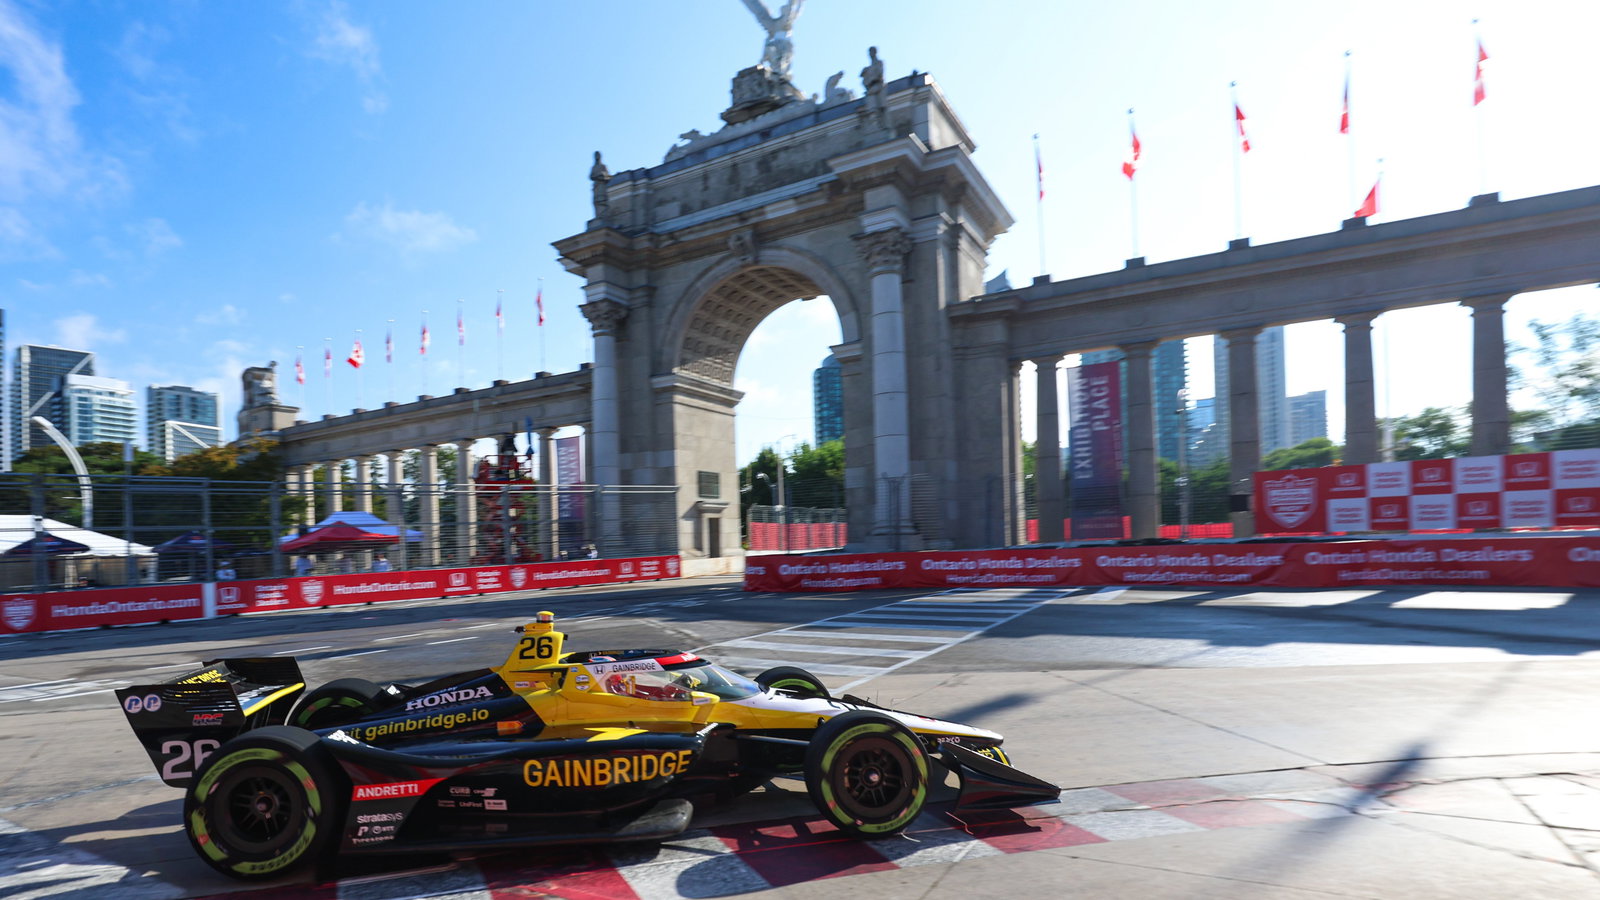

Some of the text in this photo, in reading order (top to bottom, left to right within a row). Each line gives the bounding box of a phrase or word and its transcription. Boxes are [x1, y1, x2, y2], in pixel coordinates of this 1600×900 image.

[1090, 375, 1110, 432] PLACE
[1071, 377, 1094, 480] EXHIBITION
[921, 556, 1082, 570] Ontario Honda Dealers
[1096, 552, 1285, 567] Ontario Honda Dealers
[1367, 547, 1437, 564] Honda
[1439, 546, 1534, 562] Dealers
[779, 562, 828, 576] Ontario
[333, 580, 437, 595] HondaOntario.com
[51, 597, 200, 618] HondaOntario.com
[518, 636, 553, 660] 26
[612, 662, 656, 673] GAINBRIDGE
[405, 685, 494, 711] HONDA
[365, 708, 489, 742] gainbridge.io
[523, 750, 692, 788] GAINBRIDGE
[356, 783, 419, 799] ANDRETTI
[356, 812, 404, 825] stratasys
